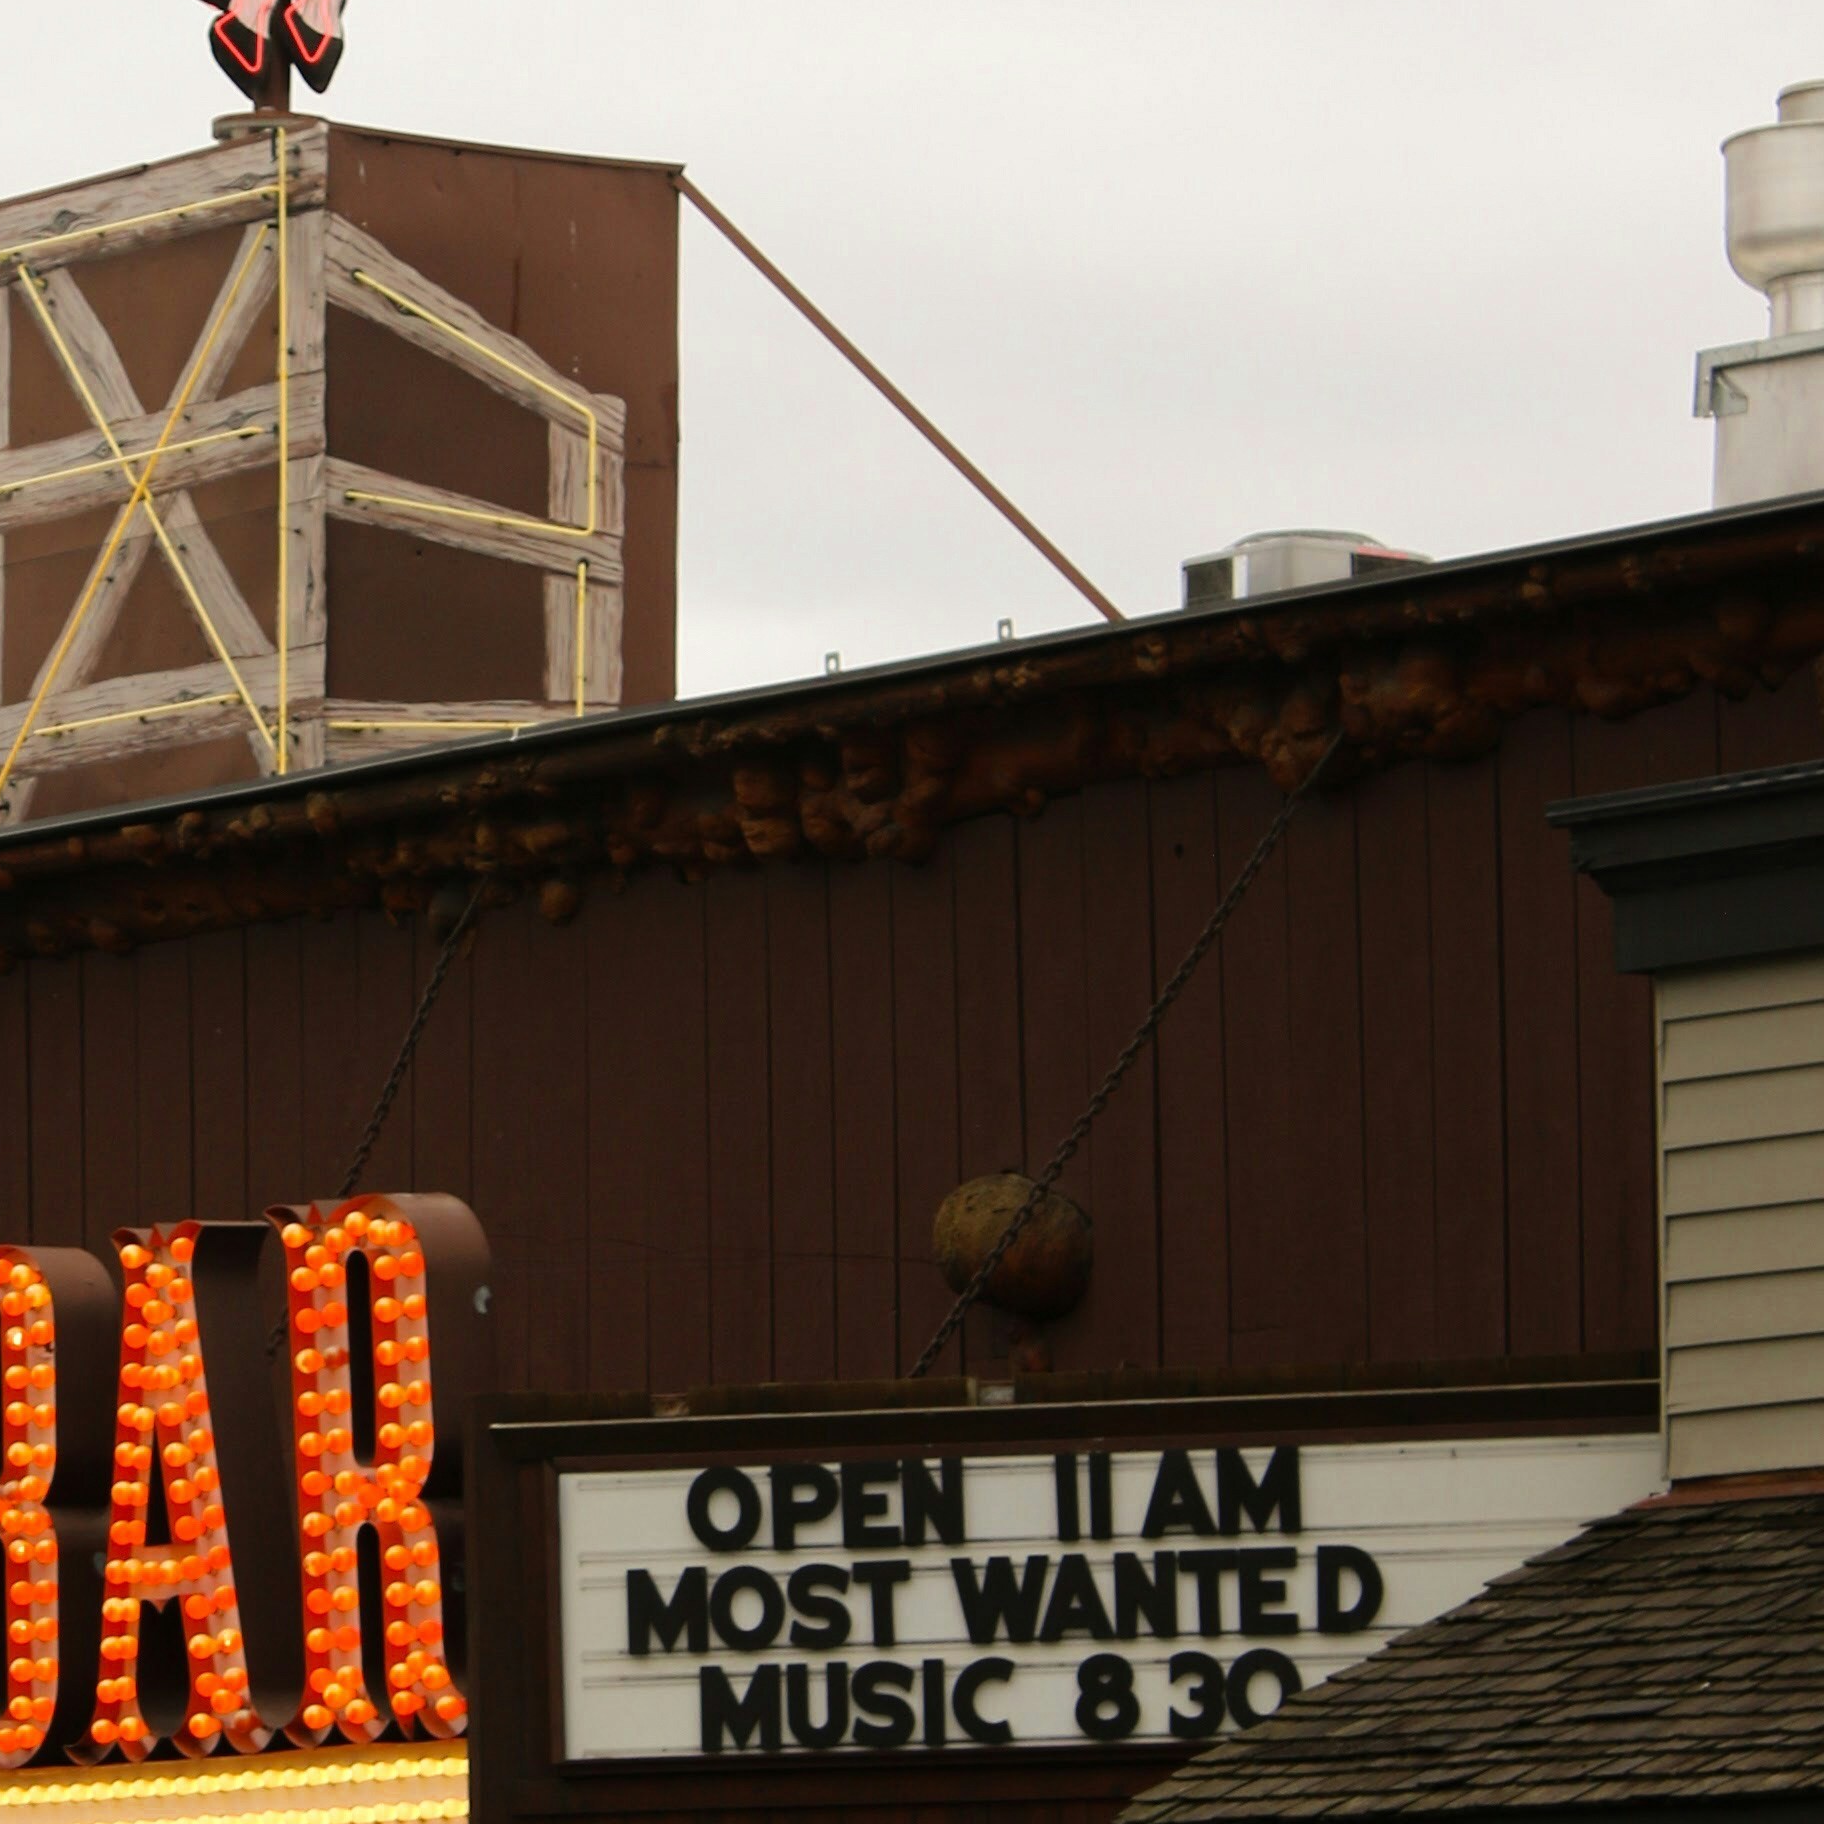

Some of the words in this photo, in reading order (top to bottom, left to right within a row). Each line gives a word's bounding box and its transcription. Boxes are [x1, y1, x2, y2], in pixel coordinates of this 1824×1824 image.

[687, 1457, 964, 1551] OPEN
[627, 1560, 910, 1655] MOST
[953, 1545, 1384, 1644] WANTED
[700, 1657, 1015, 1753] MUSIC
